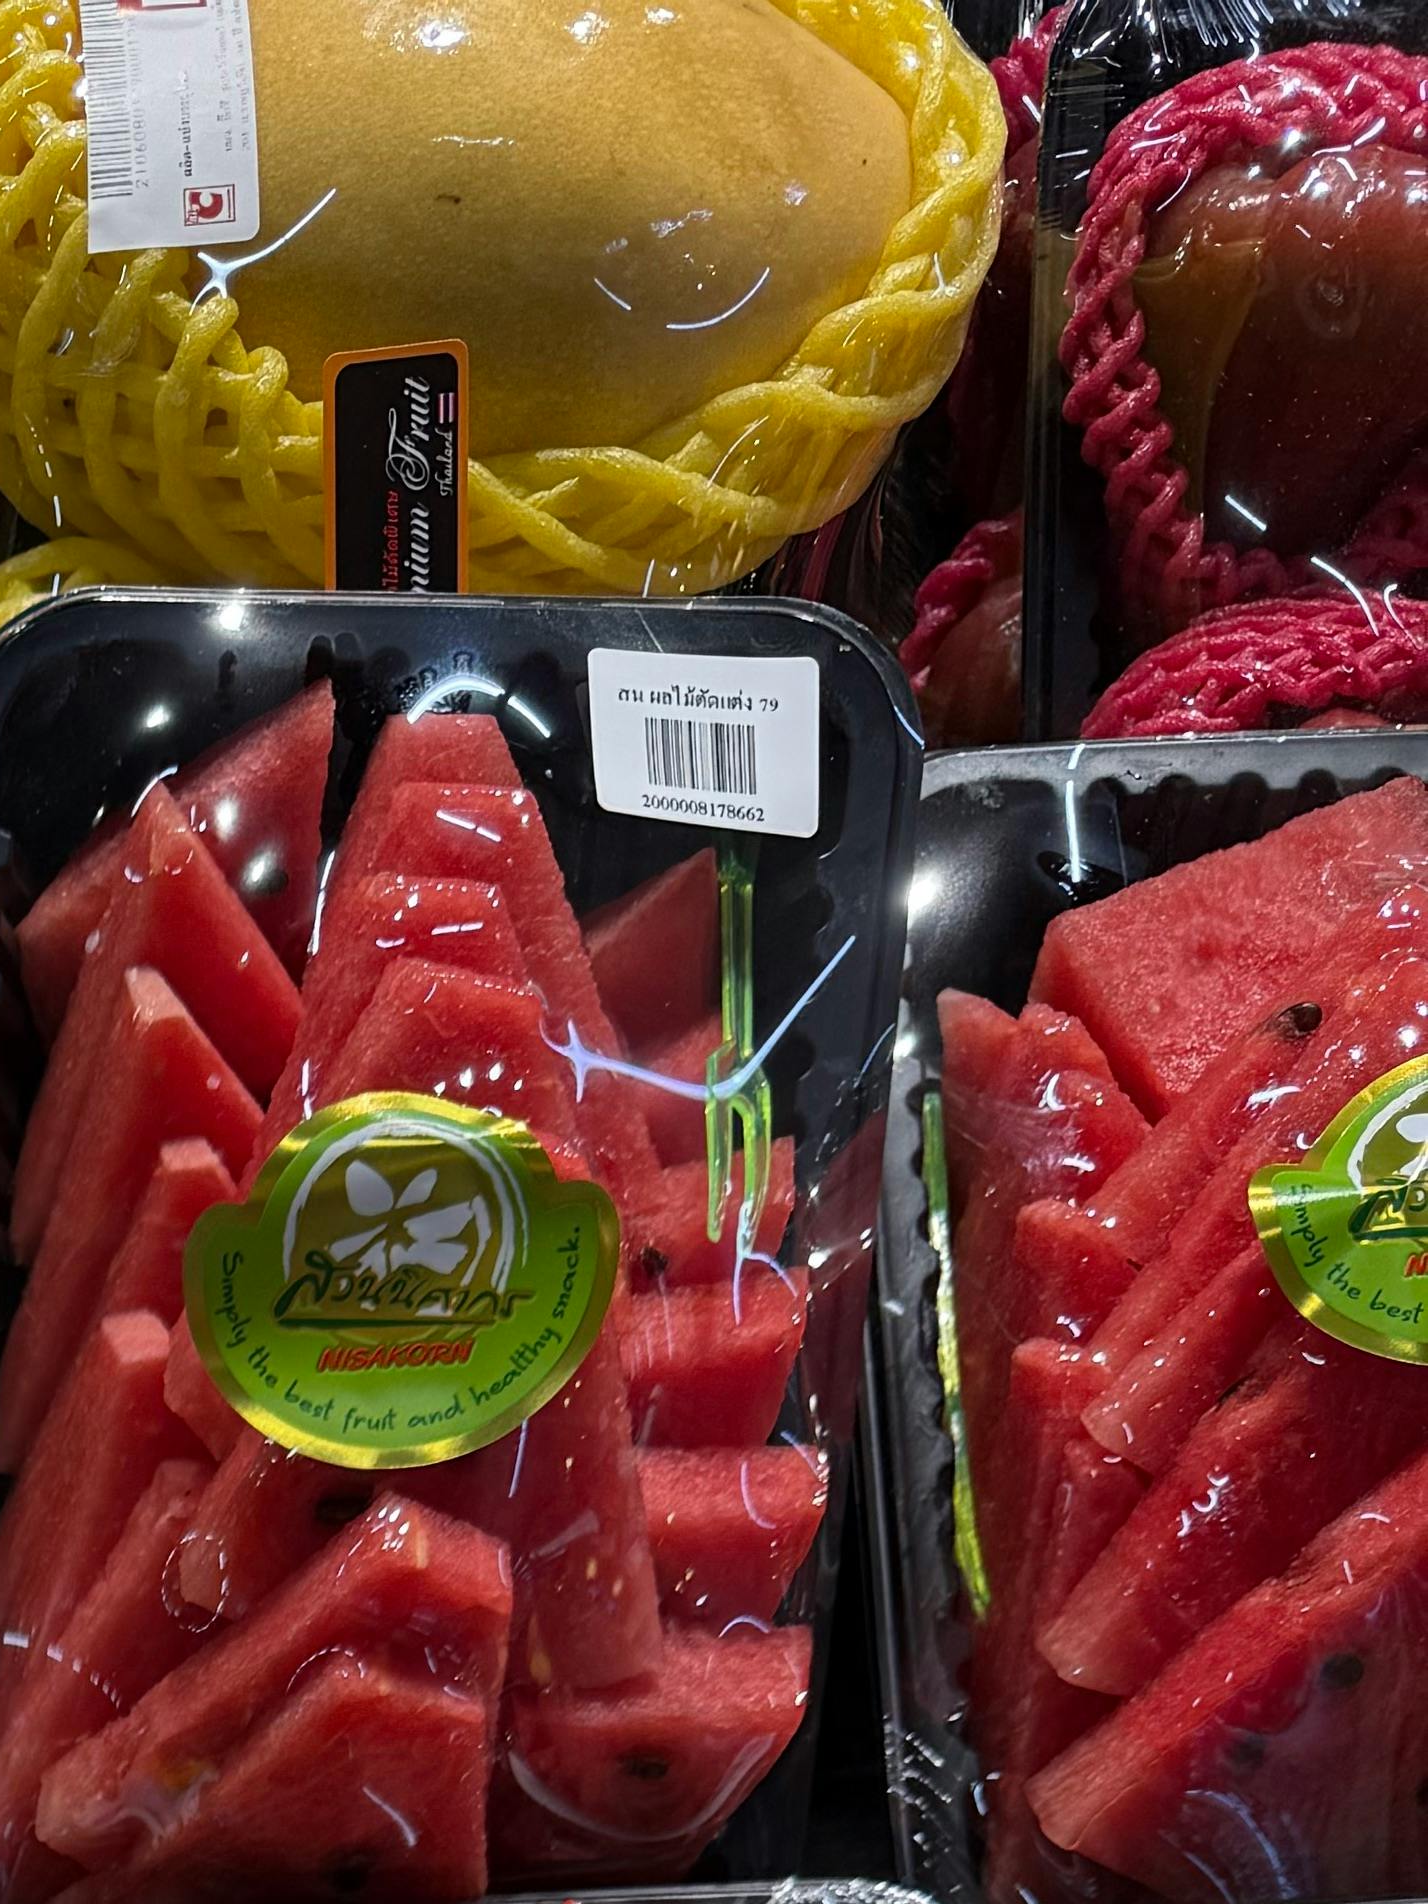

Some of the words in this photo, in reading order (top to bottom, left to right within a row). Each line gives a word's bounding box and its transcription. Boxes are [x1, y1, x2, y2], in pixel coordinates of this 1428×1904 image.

[385, 377, 430, 490] Fruit
[435, 427, 454, 496] Thailand
[759, 697, 779, 712] 79
[642, 794, 765, 822] 2000008178662
[1326, 1263, 1361, 1301] the
[1368, 1289, 1424, 1325] best
[213, 1252, 246, 1347] Simply
[248, 1346, 278, 1387] the
[285, 1384, 334, 1421] best
[342, 1411, 397, 1433] fruit
[408, 1396, 465, 1427] and
[468, 1327, 561, 1405] healthy
[550, 1226, 581, 1318] snack.
[319, 1340, 470, 1372] NISAKORN
